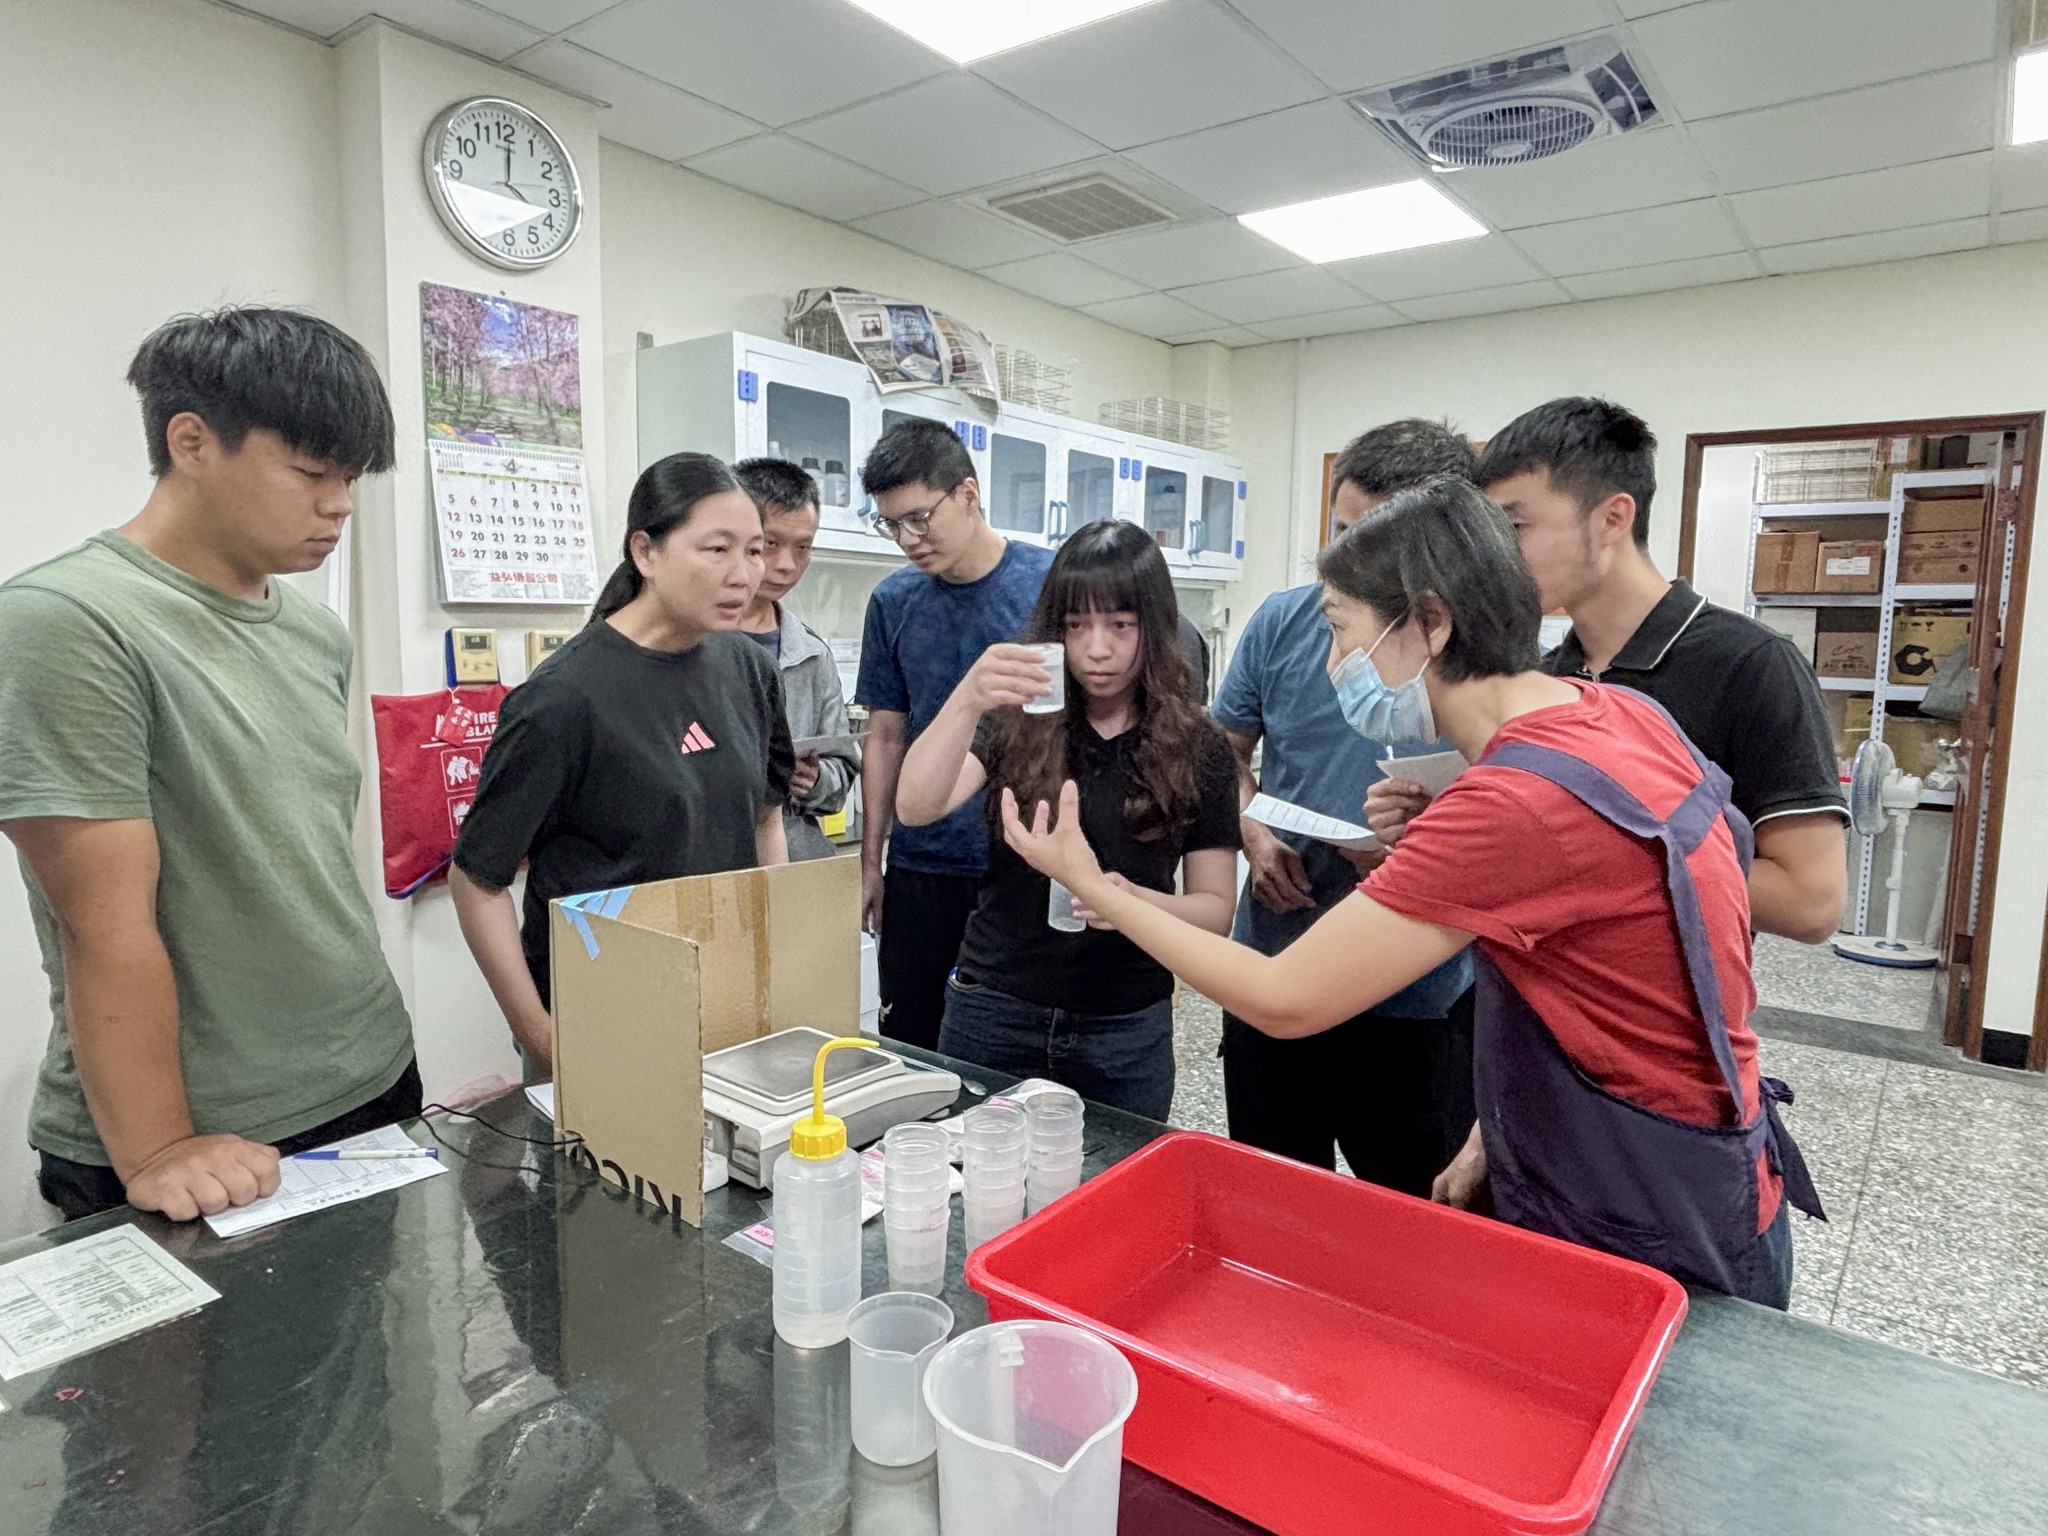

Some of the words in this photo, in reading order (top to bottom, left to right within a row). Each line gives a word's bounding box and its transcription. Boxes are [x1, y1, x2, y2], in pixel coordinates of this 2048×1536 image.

[474, 122, 490, 144] 11
[495, 121, 515, 144] 12
[457, 136, 476, 158] 10
[528, 139, 534, 157] 1
[449, 159, 462, 180] 9
[541, 162, 552, 180] 2
[549, 189, 561, 208] 3
[543, 213, 554, 231] 4
[503, 229, 515, 246] 6
[527, 226, 539, 244] 5
[506, 459, 516, 473] 4
[511, 482, 515, 491] 1
[531, 484, 537, 492] 2
[571, 488, 577, 496] 4
[449, 495, 455, 503] 5
[471, 496, 476, 505] 6
[491, 498, 497, 507] 7
[513, 500, 519, 508] 8
[533, 502, 539, 510] 9
[551, 503, 562, 511] 10
[571, 505, 580, 513] 11
[448, 512, 461, 522] 12
[470, 514, 482, 523] 13
[490, 515, 503, 525] 14
[512, 517, 525, 526] 15
[533, 518, 545, 527] 16
[552, 520, 564, 528] 17
[572, 521, 584, 530] 18
[450, 530, 462, 539] 19
[471, 532, 484, 541] 20
[492, 533, 504, 542] 21
[514, 534, 527, 543] 22
[534, 536, 546, 545] 23
[554, 537, 566, 545] 24
[573, 538, 585, 546] 25
[451, 549, 465, 558] 26
[473, 550, 486, 558] 27
[494, 551, 508, 559] 28
[516, 552, 528, 560] 29
[536, 553, 548, 561] 30
[474, 711, 497, 725] IRE
